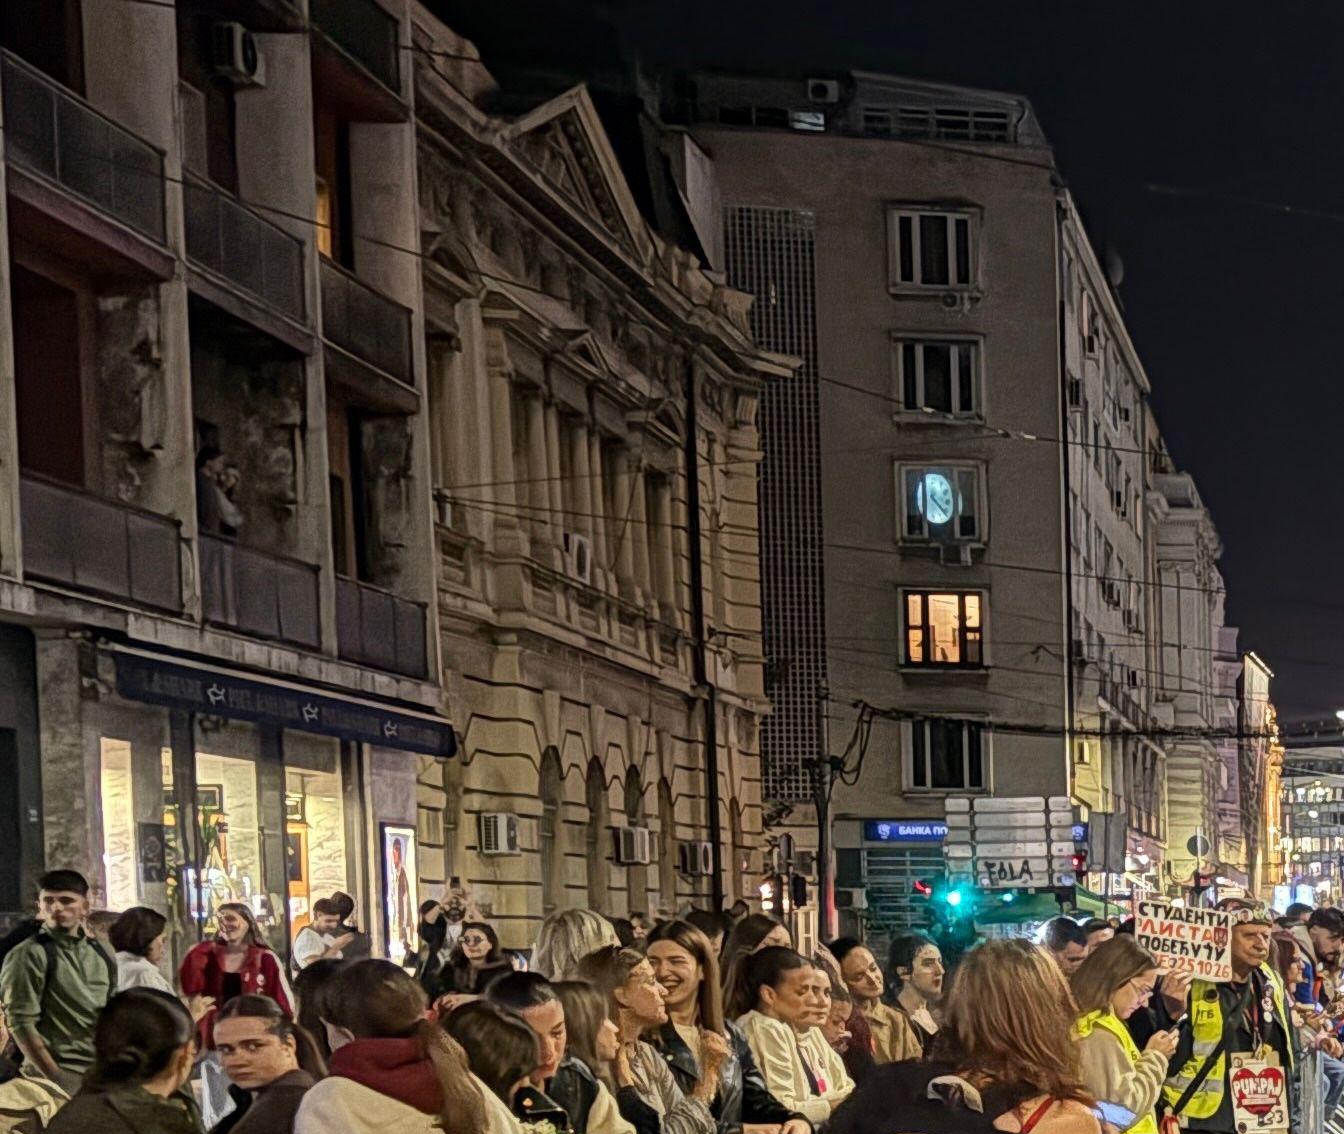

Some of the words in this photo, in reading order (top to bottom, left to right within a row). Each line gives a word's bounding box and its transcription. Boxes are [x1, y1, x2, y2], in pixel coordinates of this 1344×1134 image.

[898, 824, 932, 836] БАНКА
[1138, 901, 1229, 928] СТУДЕНТИ
[1141, 918, 1213, 942] ЛИСТА
